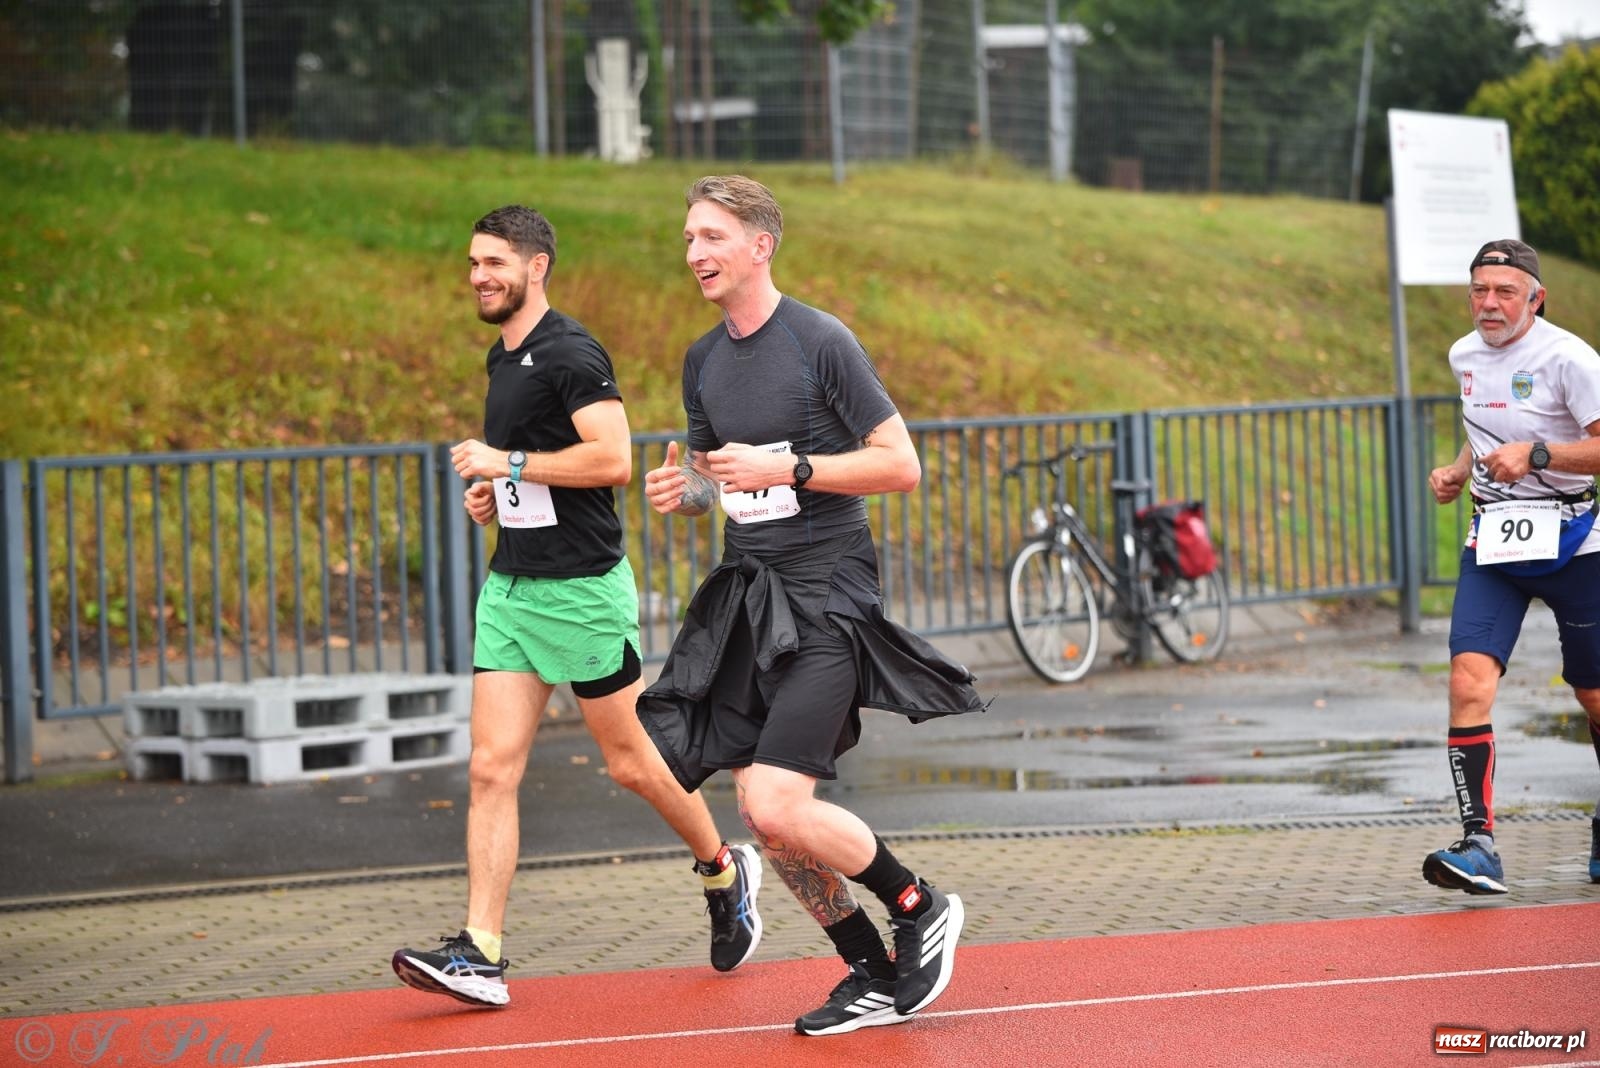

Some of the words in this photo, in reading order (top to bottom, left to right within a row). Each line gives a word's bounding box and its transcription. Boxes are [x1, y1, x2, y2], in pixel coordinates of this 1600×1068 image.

[505, 481, 520, 508] 3
[739, 507, 769, 518] Racibórz
[1501, 518, 1534, 543] 90
[1449, 747, 1474, 817] kalenji
